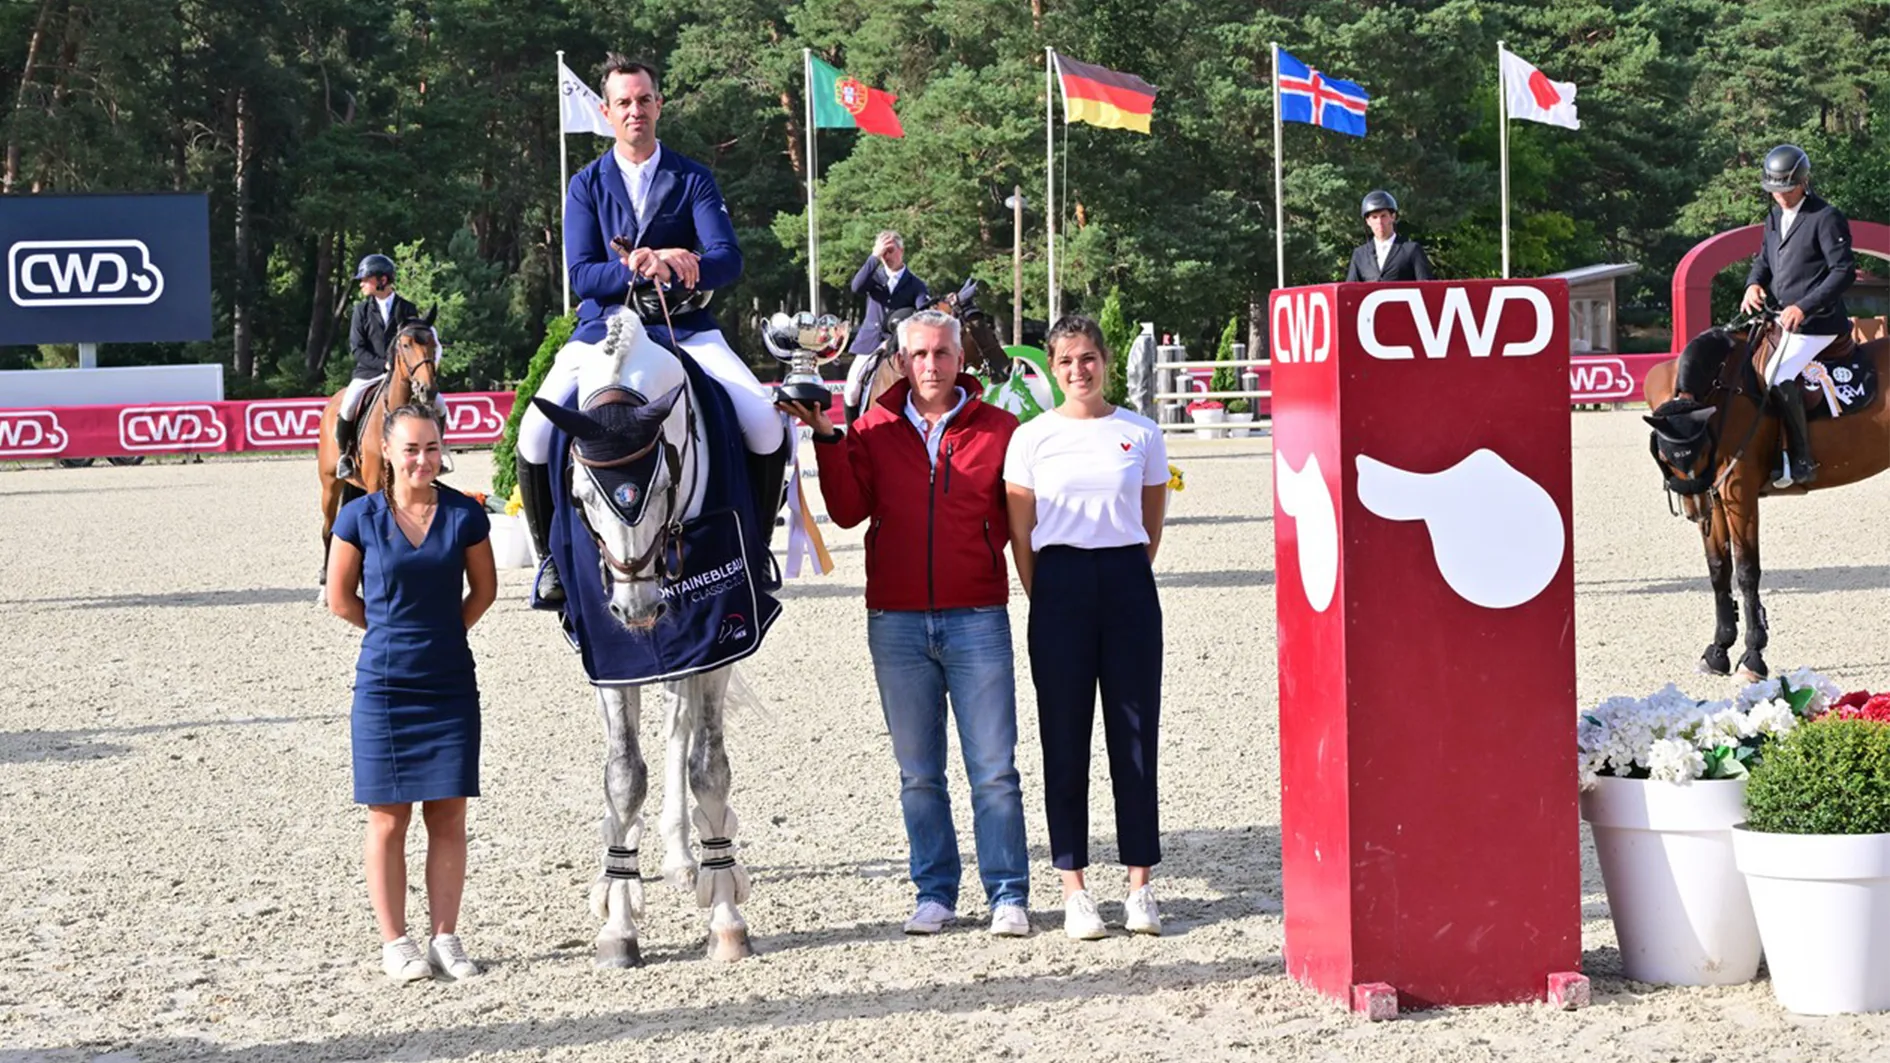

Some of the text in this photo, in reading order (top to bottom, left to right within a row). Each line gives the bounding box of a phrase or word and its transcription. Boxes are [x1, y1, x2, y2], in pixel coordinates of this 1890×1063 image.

[21, 253, 128, 294] CWD
[1273, 292, 1330, 363] CWD
[1357, 286, 1554, 359] CWD
[1570, 366, 1613, 391] WD
[0, 420, 43, 447] WD
[127, 414, 202, 442] CWD
[657, 556, 744, 599] ONTAINEBLEAU
